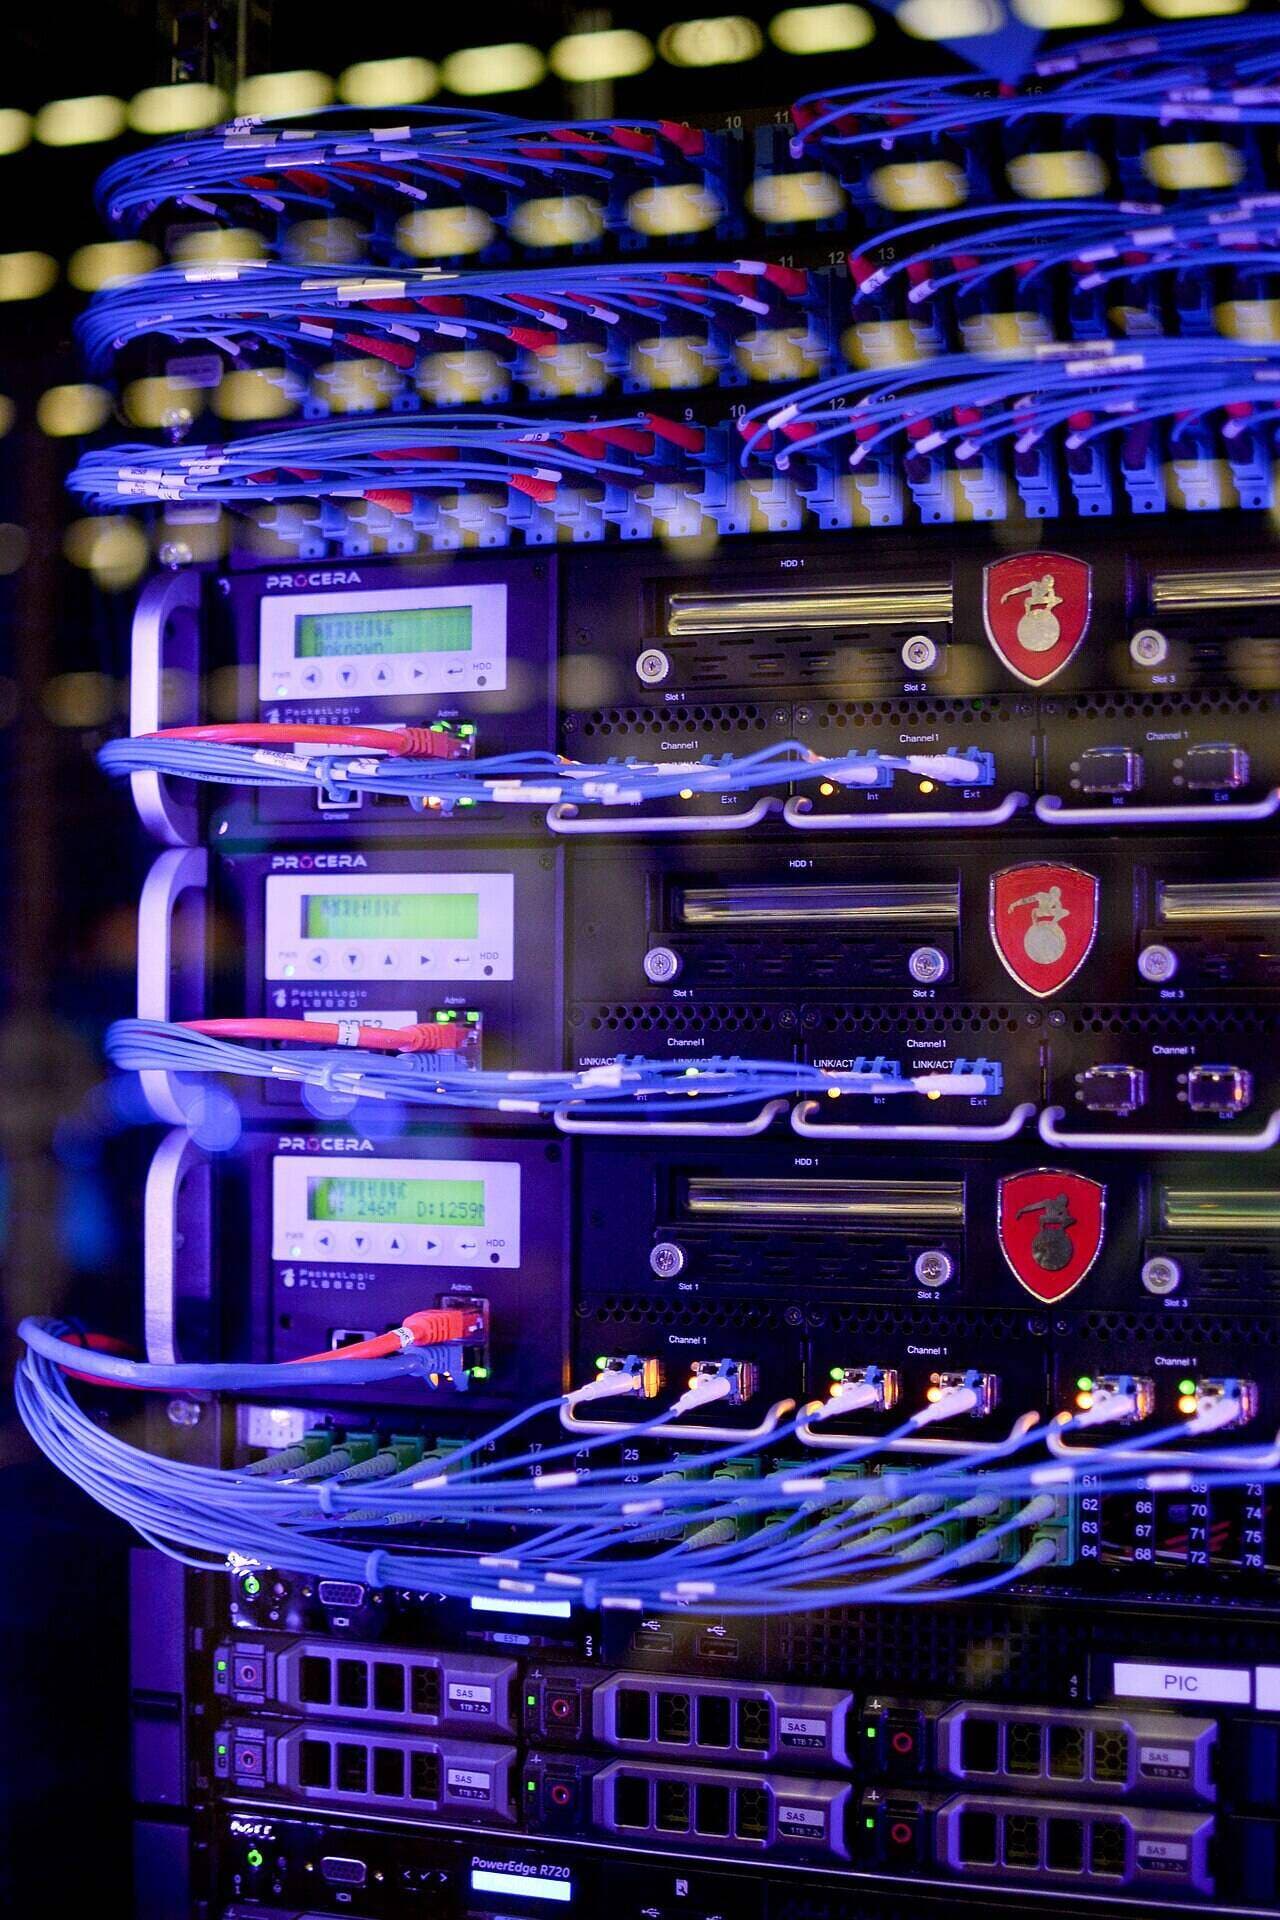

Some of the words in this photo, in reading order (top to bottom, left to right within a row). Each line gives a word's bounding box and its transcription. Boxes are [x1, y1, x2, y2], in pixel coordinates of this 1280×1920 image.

[725, 116, 742, 128] 10
[774, 111, 789, 123] 11
[829, 251, 845, 264] 12
[879, 248, 895, 260] 13
[779, 256, 793, 267] 11
[829, 398, 846, 410] 12
[685, 408, 693, 421] 9
[730, 404, 746, 417] 10
[266, 571, 361, 589] PROCERA
[473, 662, 492, 671] HDD
[1151, 675, 1167, 684] Slot
[1169, 675, 1176, 683] 3
[904, 684, 918, 692] Slot
[921, 683, 927, 691] 2
[665, 693, 679, 701] Slot
[437, 709, 459, 718] Admin
[1146, 732, 1182, 741] Channel
[867, 792, 879, 800] Int
[964, 790, 980, 798] Ext
[1214, 792, 1229, 801] Ext
[721, 796, 737, 804] Ext
[1112, 796, 1124, 804] Int
[271, 854, 368, 869] PROCERA
[789, 860, 806, 868] HDD
[480, 952, 499, 960] HDD
[673, 989, 687, 997] Slot
[913, 990, 927, 998] Slot
[929, 990, 935, 998] 2
[1160, 990, 1175, 998] Slot
[1178, 989, 1184, 998] 3
[444, 997, 466, 1005] Admin
[1152, 1045, 1188, 1055] Channel
[813, 1059, 854, 1068] LINK/ACT
[912, 1060, 954, 1069] LINK/ACT
[874, 1095, 886, 1104] Int
[970, 1097, 988, 1106] Ext
[278, 1136, 374, 1151] PROCERA
[794, 1158, 812, 1166] HDD
[486, 1239, 505, 1247] HDD
[679, 1282, 693, 1290] Slot
[917, 1291, 932, 1299] Slot
[934, 1292, 940, 1300] 2
[1164, 1298, 1180, 1307] Slot
[1182, 1298, 1188, 1308] 3
[668, 1335, 700, 1344] Channel
[907, 1345, 941, 1355] Channel
[1154, 1356, 1190, 1366] Channel
[529, 1443, 543, 1453] 17
[576, 1448, 590, 1458] 21
[624, 1449, 639, 1460] 25
[528, 1465, 542, 1477] 18
[624, 1471, 639, 1483] 26
[1082, 1475, 1098, 1487] 61
[1191, 1481, 1207, 1494] 69
[1246, 1484, 1262, 1496] 73
[1082, 1498, 1098, 1511] 62
[1135, 1501, 1152, 1514] 66
[1191, 1504, 1207, 1516] 70
[1246, 1507, 1262, 1519] 74
[1082, 1521, 1098, 1534] 63
[1135, 1525, 1151, 1537] 67
[1190, 1528, 1206, 1540] 71
[1245, 1530, 1261, 1543] 75
[1081, 1544, 1098, 1557] 64
[1135, 1548, 1151, 1560] 68
[1190, 1551, 1206, 1564] 72
[1245, 1554, 1261, 1567] 76
[504, 1635, 518, 1643] EST
[585, 1635, 592, 1645] 2
[585, 1647, 592, 1656] 3
[1069, 1675, 1078, 1685] 4
[1164, 1674, 1198, 1692] PIC
[456, 1689, 473, 1698] SAS
[1069, 1687, 1078, 1698] 5
[787, 1722, 807, 1732] SAS
[1148, 1752, 1169, 1762] SAS
[455, 1774, 472, 1784] SAS
[786, 1811, 805, 1821] SAS
[1146, 1845, 1166, 1856] SAS
[471, 1856, 537, 1875] PowerEdge
[539, 1865, 570, 1878] R720
